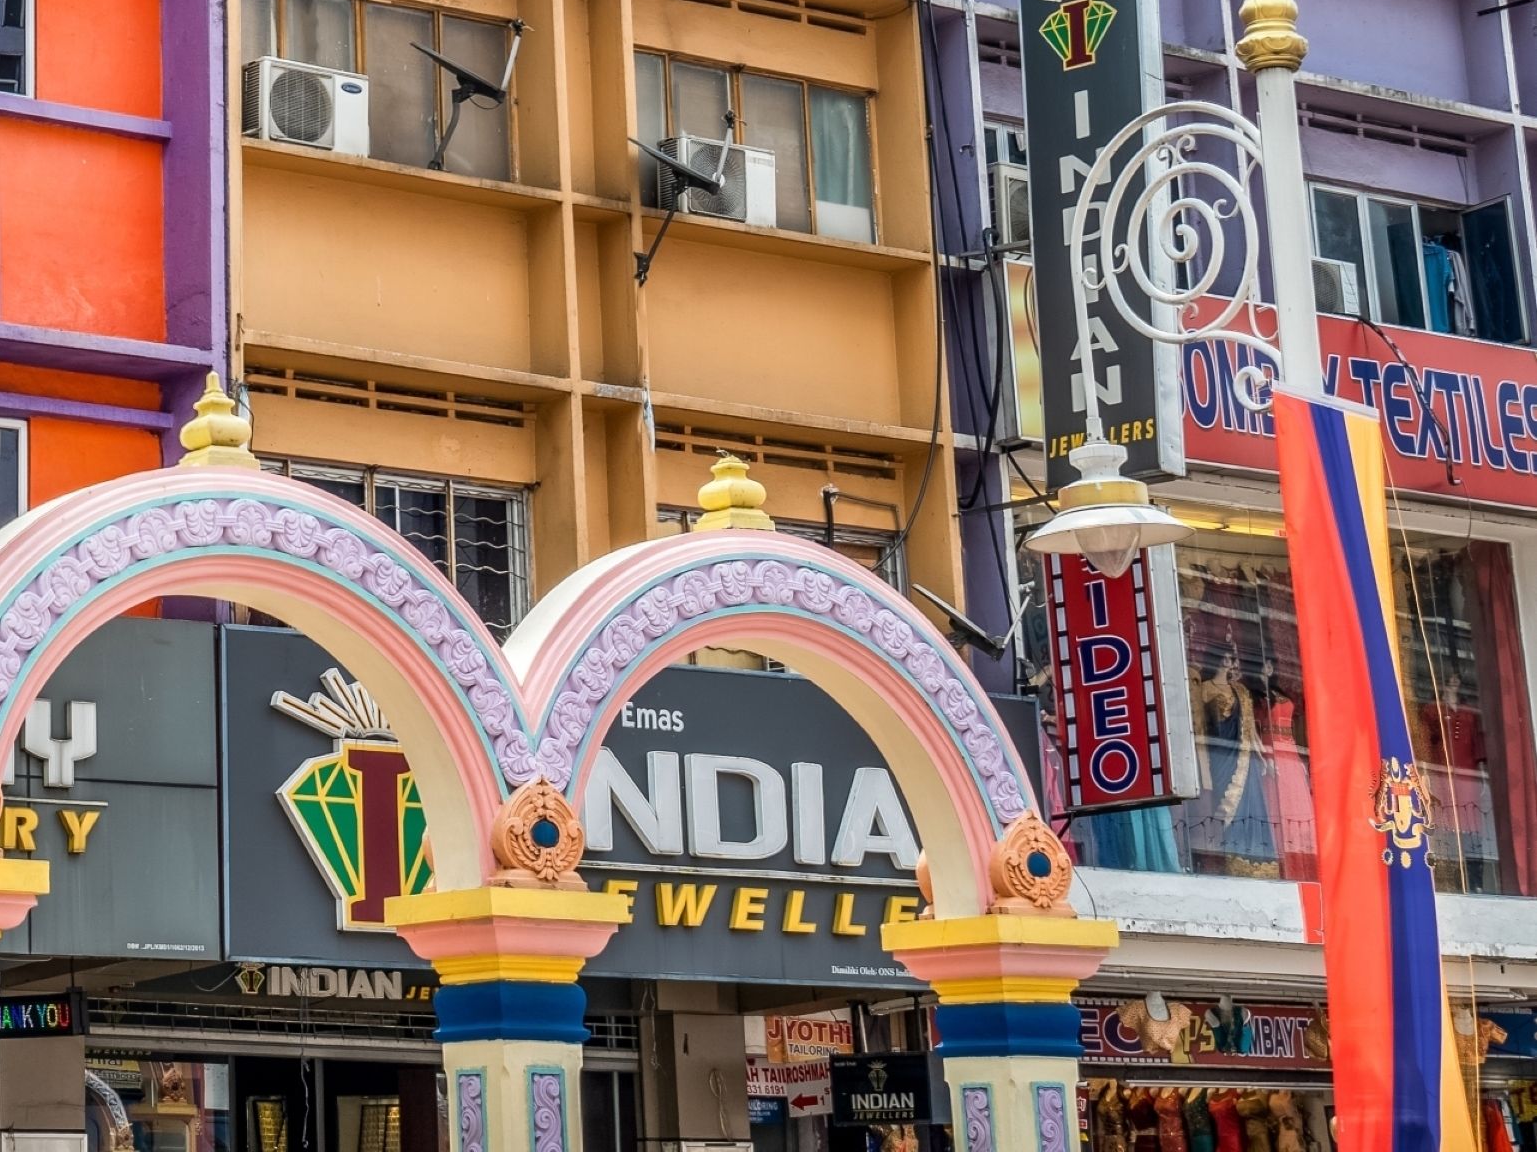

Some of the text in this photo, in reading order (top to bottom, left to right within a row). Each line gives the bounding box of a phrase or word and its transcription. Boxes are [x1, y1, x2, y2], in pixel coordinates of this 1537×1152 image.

[1058, 89, 1123, 413] INDIAN
[1049, 417, 1155, 459] JEWLERS
[1076, 554, 1140, 794] IDEO
[621, 701, 685, 733] Emas
[581, 747, 920, 871] NDIA
[266, 966, 403, 1001] INDIAN
[36, 1003, 70, 1028] YOU
[768, 1016, 852, 1045] JYOTHI
[788, 1043, 839, 1056] TAILORING
[851, 1092, 914, 1110] INDIAN
[853, 1110, 915, 1121] JEWELLERS
